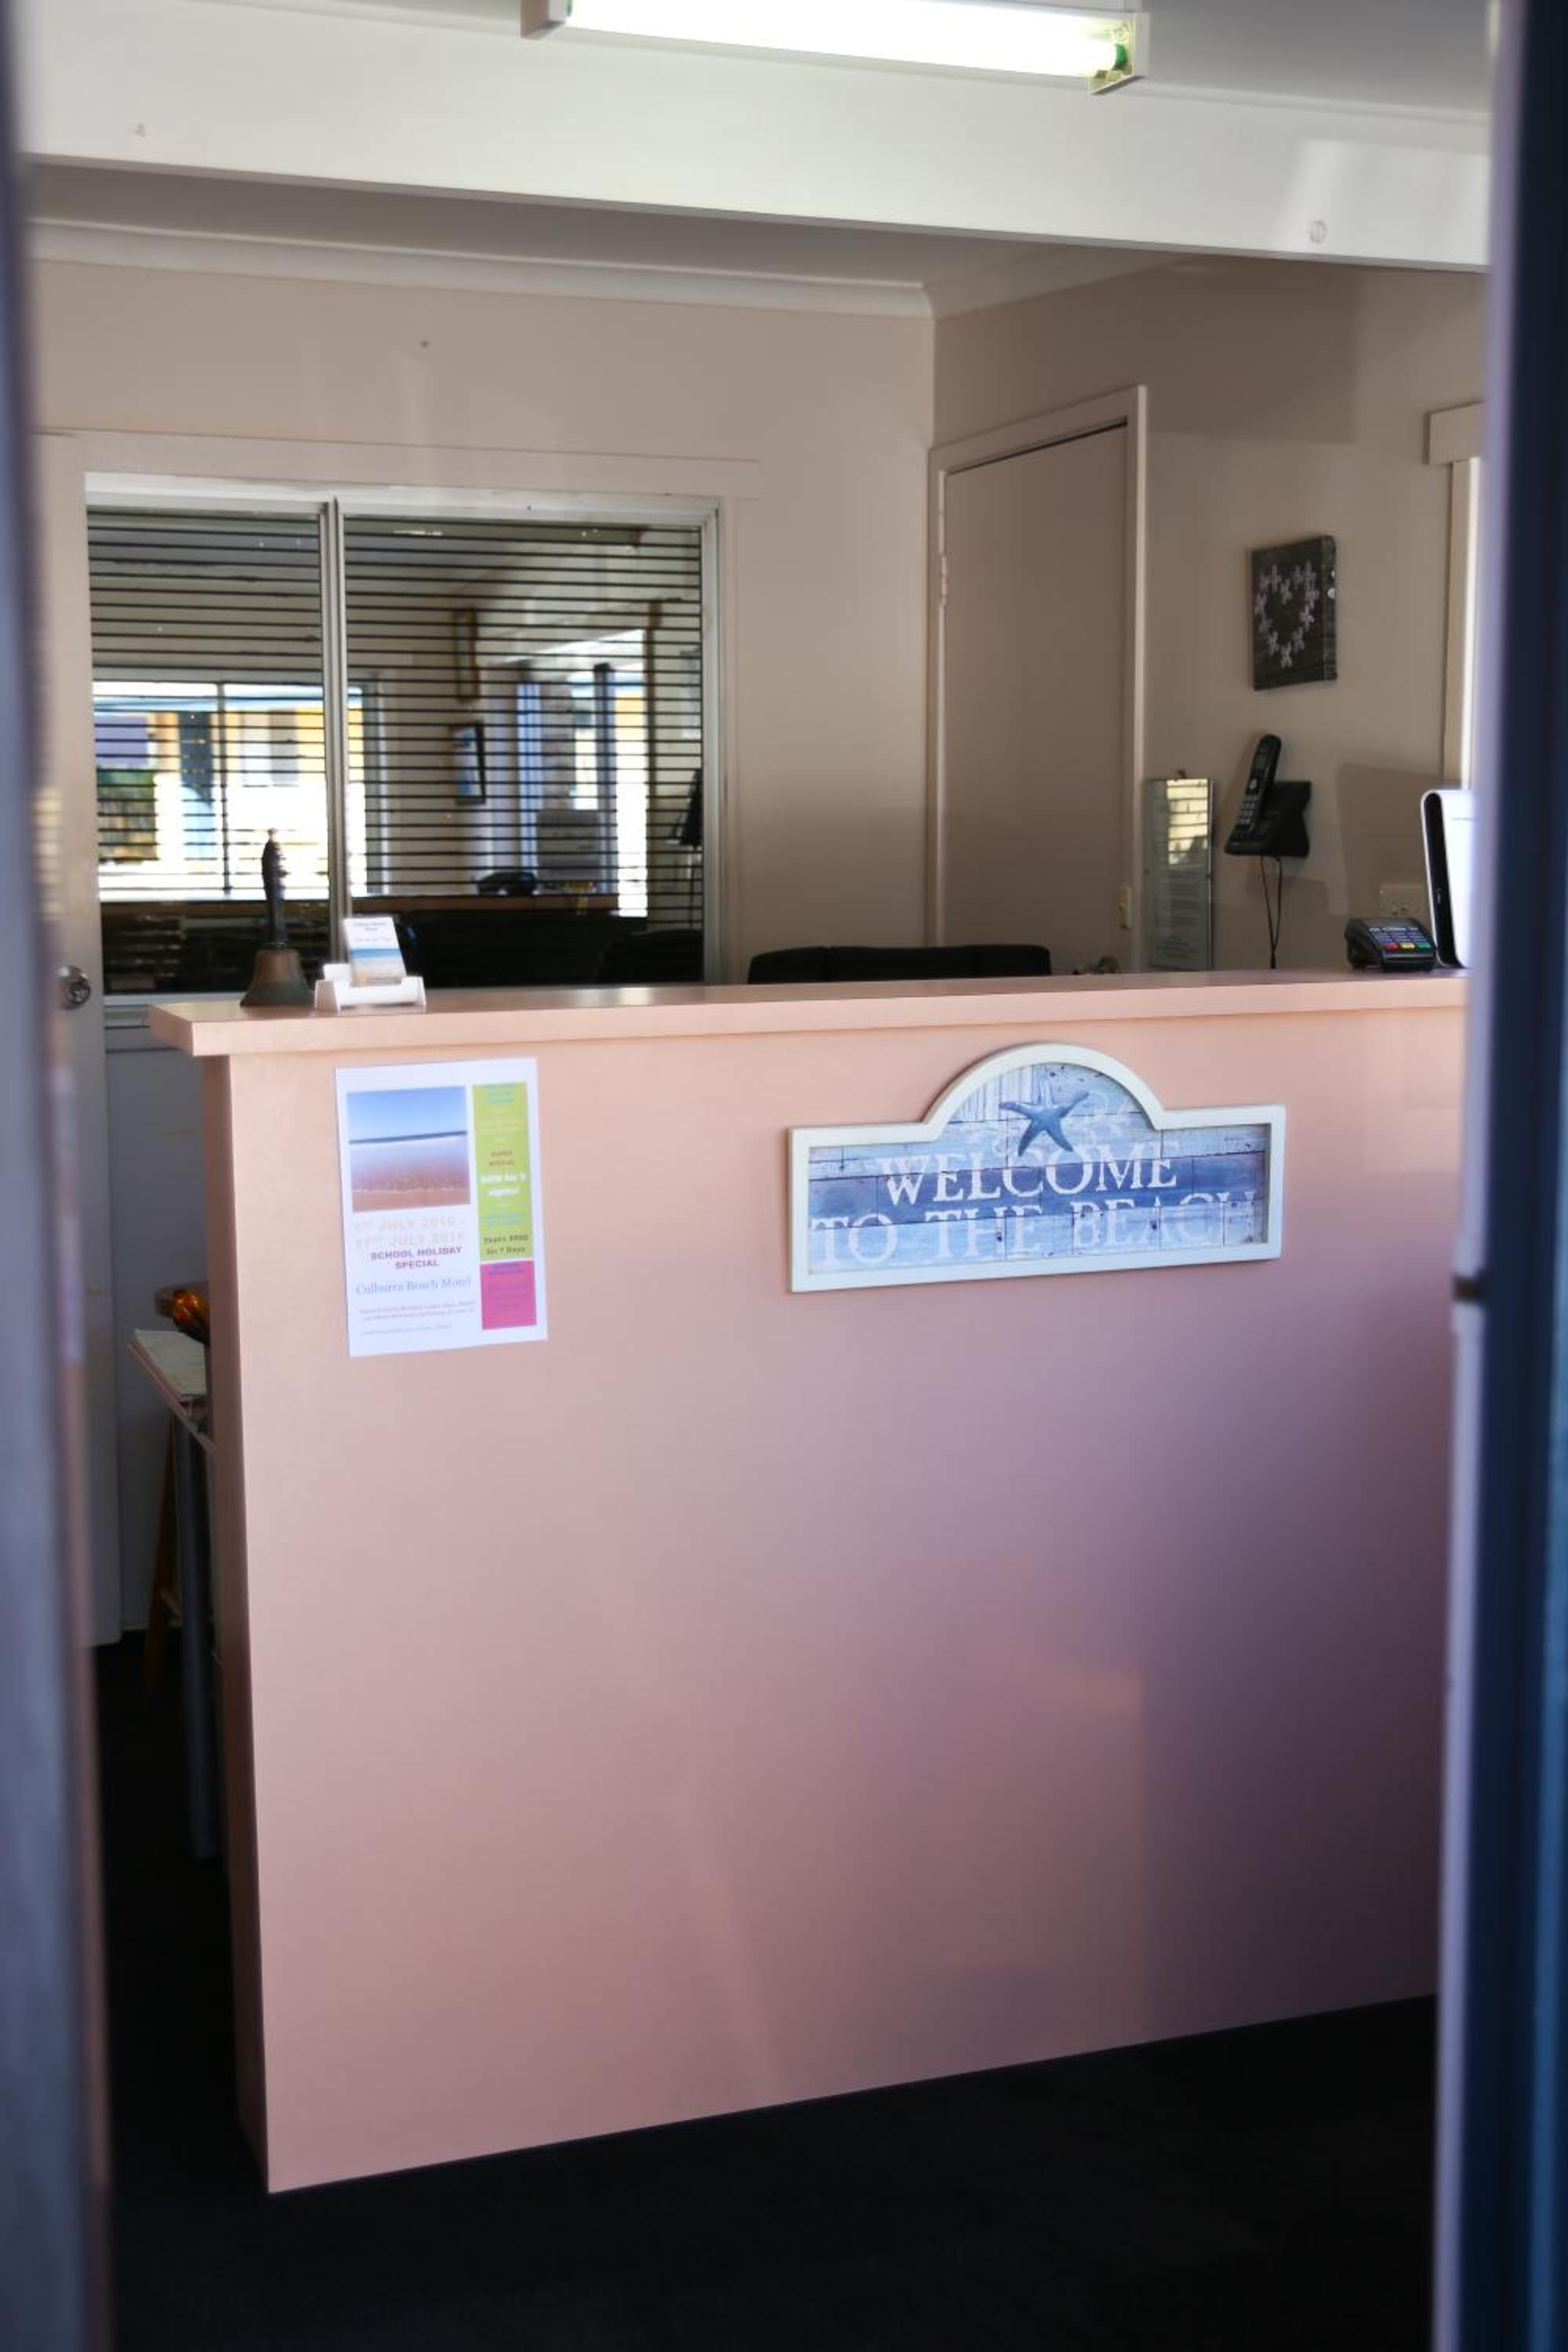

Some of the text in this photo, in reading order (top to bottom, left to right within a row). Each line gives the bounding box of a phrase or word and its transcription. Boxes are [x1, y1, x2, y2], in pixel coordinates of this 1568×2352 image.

[875, 1142, 1179, 1206] WELCOME
[811, 1191, 1257, 1267] TO THE BEACH
[371, 1246, 463, 1261] SCHOOL HOLIDAY
[394, 1258, 439, 1269] SPECIAL
